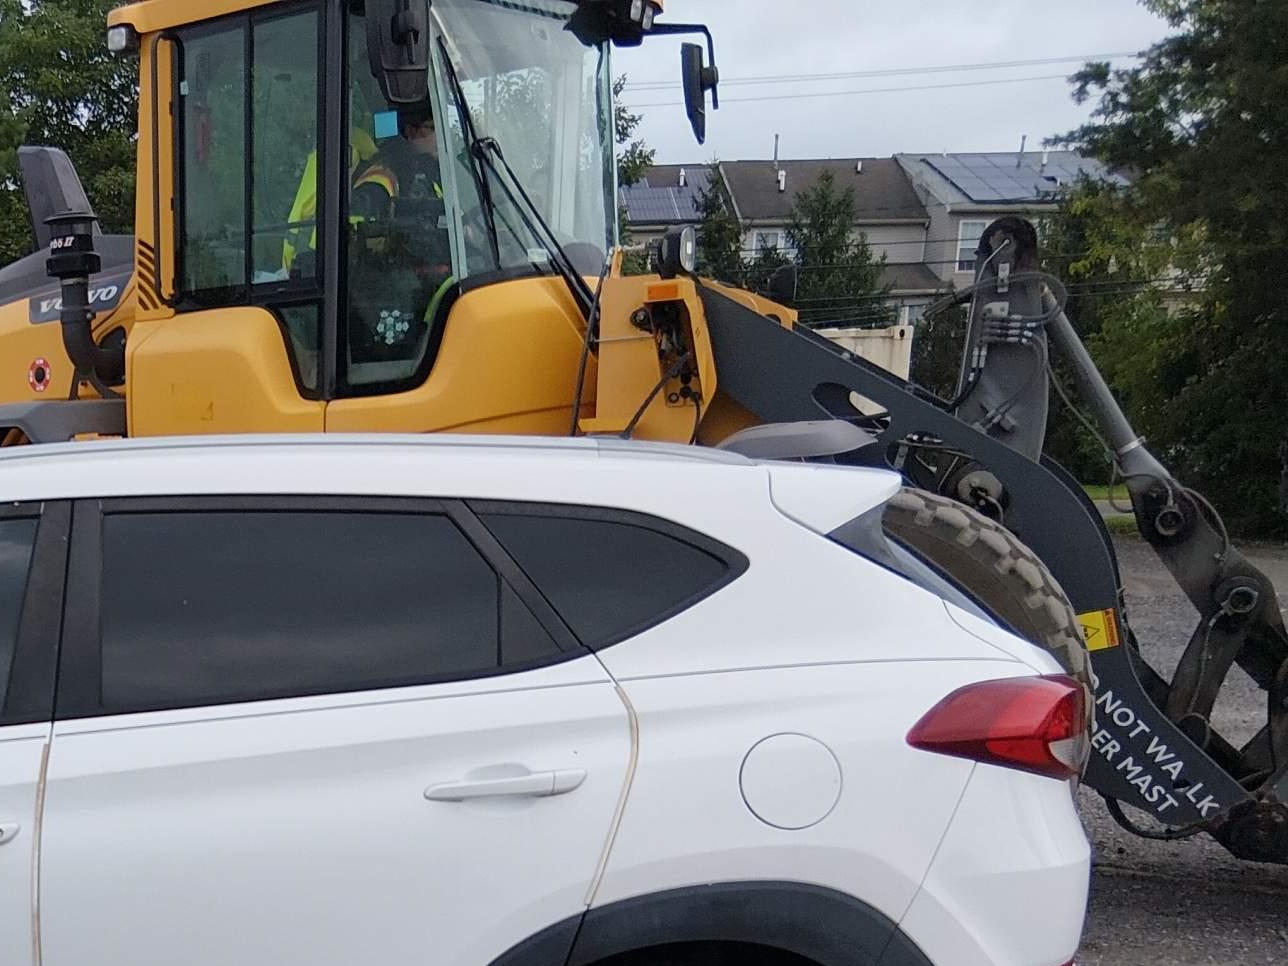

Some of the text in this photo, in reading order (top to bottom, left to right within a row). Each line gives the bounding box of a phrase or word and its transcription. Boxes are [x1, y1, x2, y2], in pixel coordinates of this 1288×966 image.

[40, 285, 118, 313] VVO
[1096, 690, 1220, 818] NOT WALK
[1116, 756, 1179, 812] MAST
